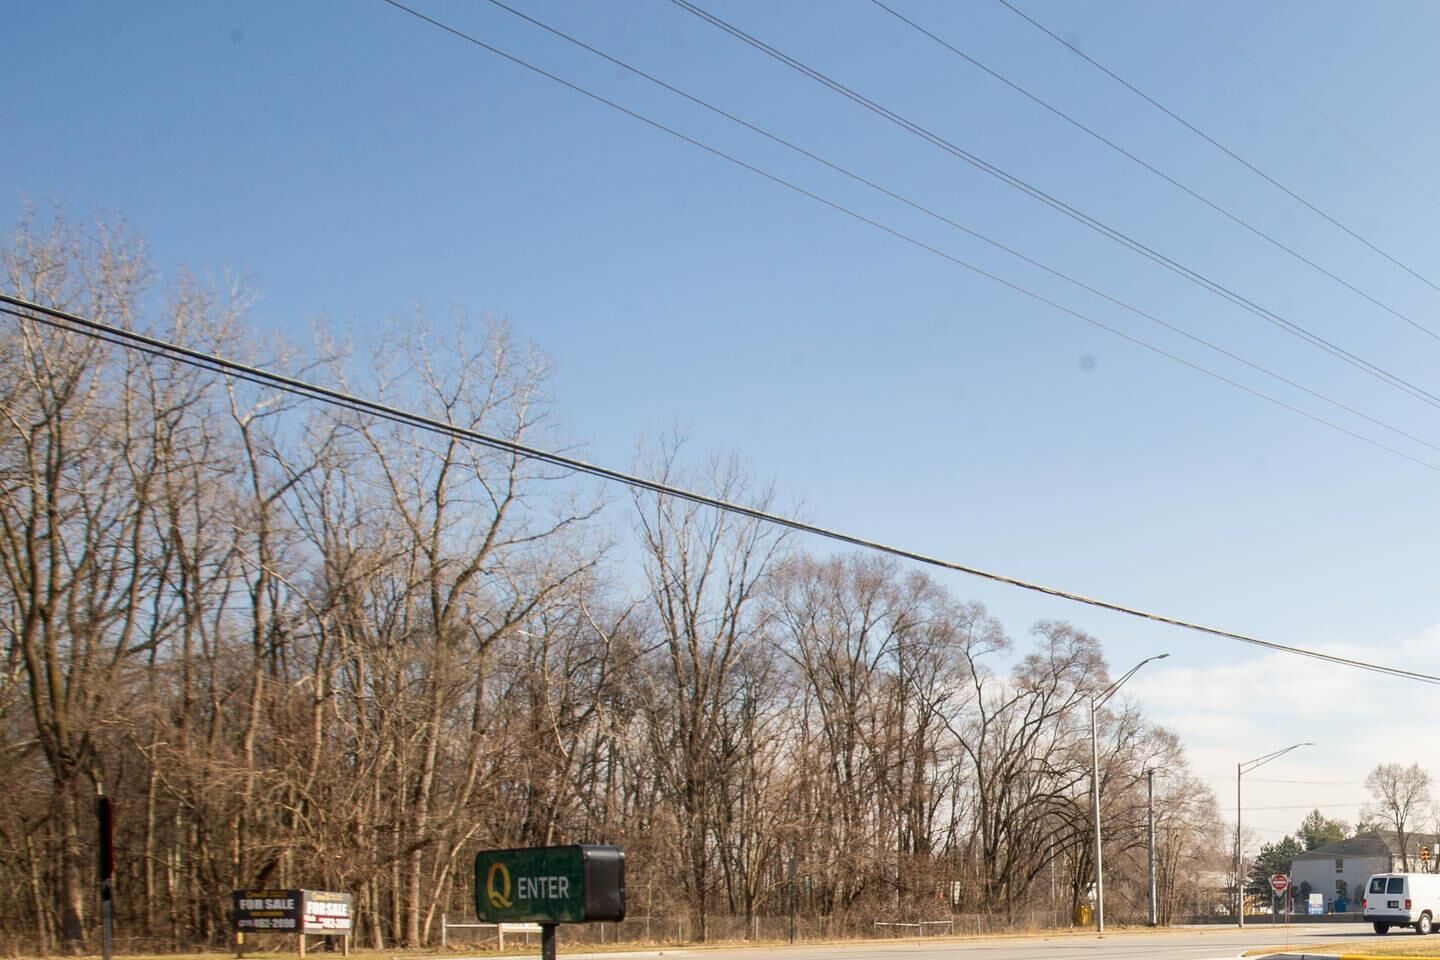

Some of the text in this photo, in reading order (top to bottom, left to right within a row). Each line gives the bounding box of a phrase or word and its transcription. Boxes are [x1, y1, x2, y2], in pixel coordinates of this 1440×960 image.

[517, 876, 570, 899] ENTER
[239, 899, 296, 910] FOR SALE
[327, 903, 348, 917] SALE
